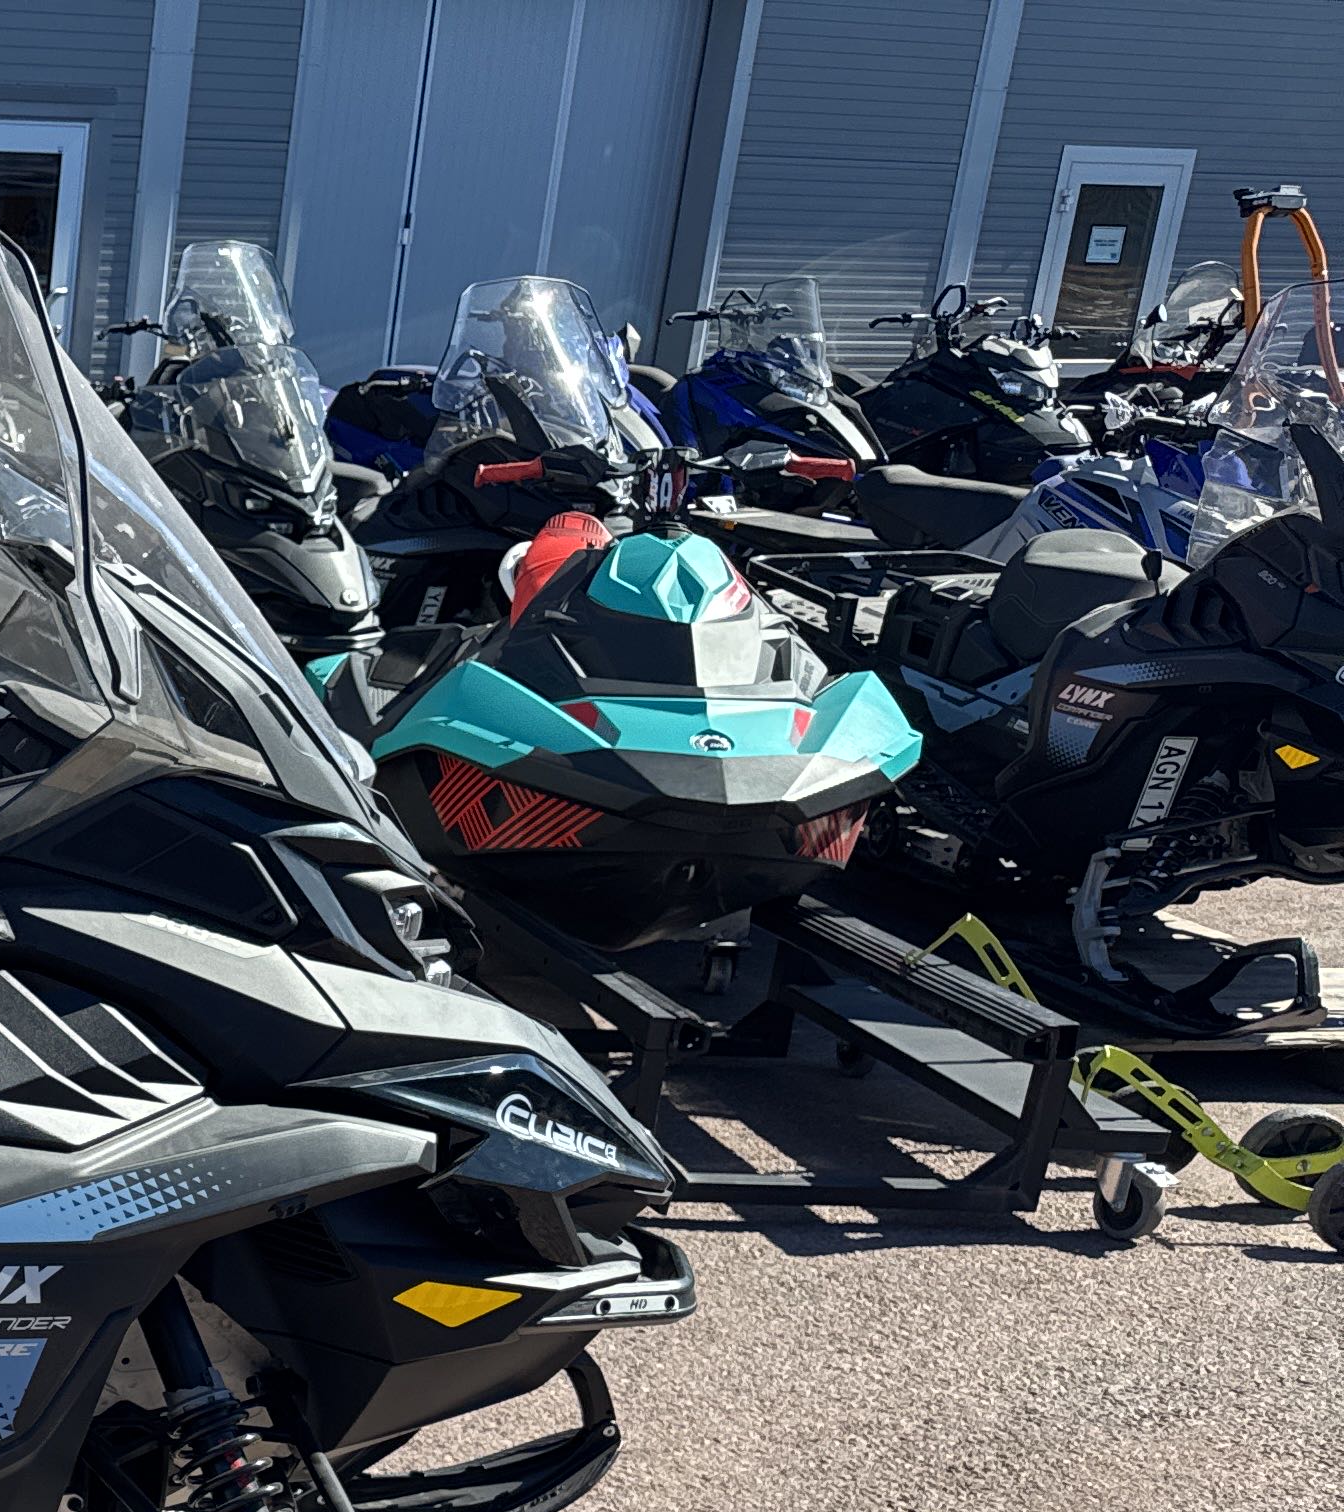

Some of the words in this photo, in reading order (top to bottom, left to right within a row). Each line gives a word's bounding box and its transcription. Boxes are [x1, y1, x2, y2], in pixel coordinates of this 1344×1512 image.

[1058, 683, 1115, 708] LYNX
[1148, 746, 1186, 791] AGN
[496, 1093, 609, 1162] CUBIC
[629, 1298, 648, 1311] HD
